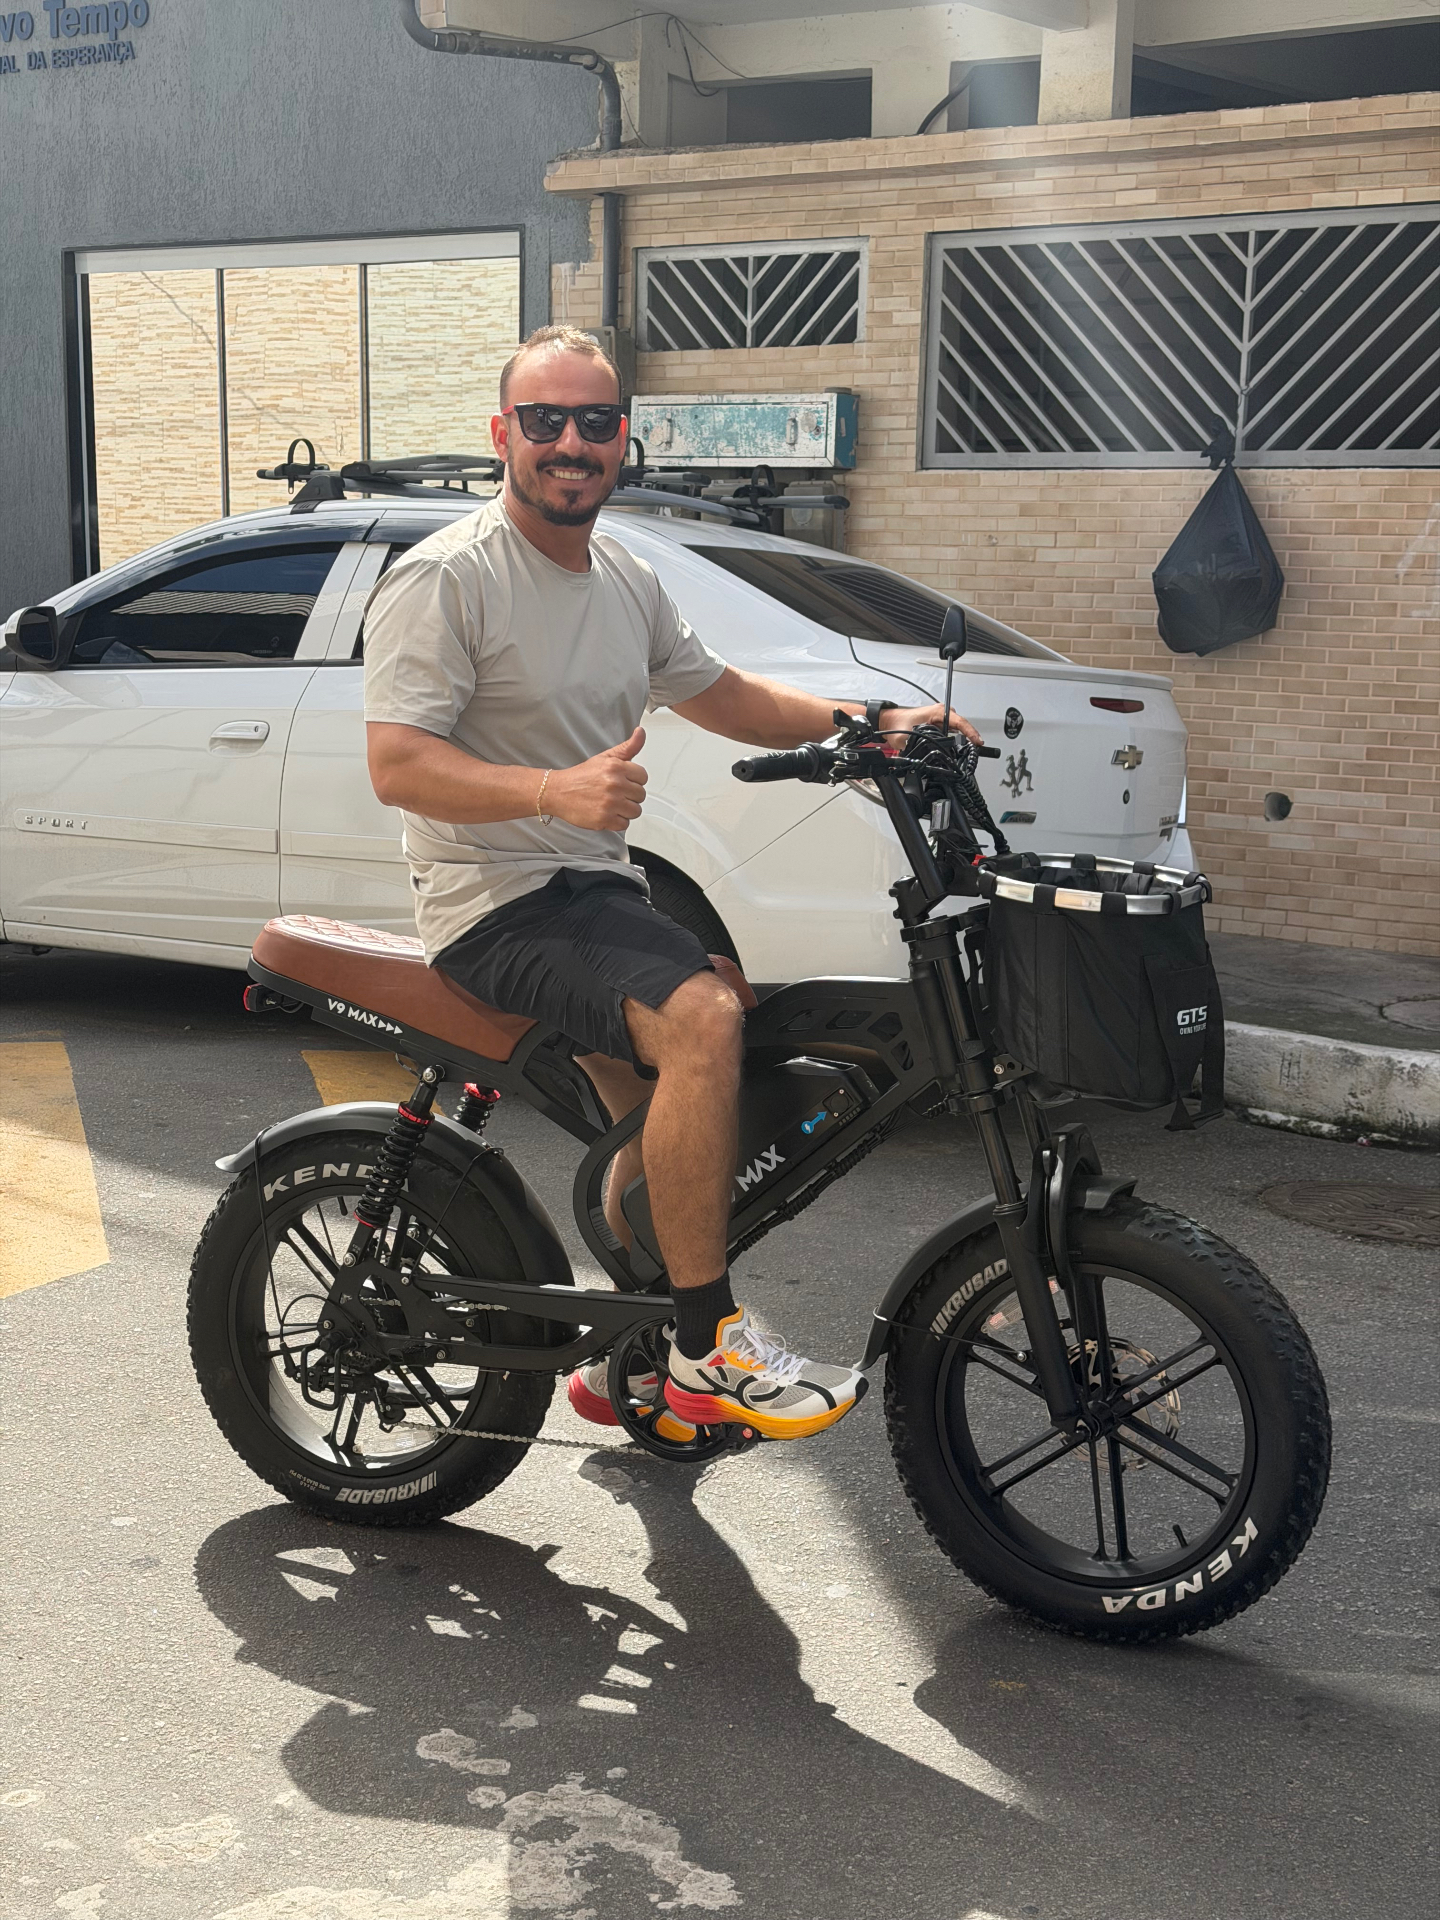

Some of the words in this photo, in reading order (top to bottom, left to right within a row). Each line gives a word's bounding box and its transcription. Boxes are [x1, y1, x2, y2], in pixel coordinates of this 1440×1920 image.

[43, 0, 149, 41] Tempo
[0, 55, 20, 74] AL
[27, 51, 47, 70] DA
[51, 41, 136, 69] ESPERANÇA
[24, 815, 88, 830] SPORT
[327, 998, 346, 1014] V9
[347, 1006, 378, 1028] MAX
[1177, 1005, 1208, 1026] GTS
[263, 1162, 409, 1202] KEND
[735, 1144, 786, 1192] MAX
[940, 1258, 1008, 1324] KRUSAD
[335, 1479, 420, 1504] KRUSADE
[1102, 1516, 1259, 1614] KENDA
